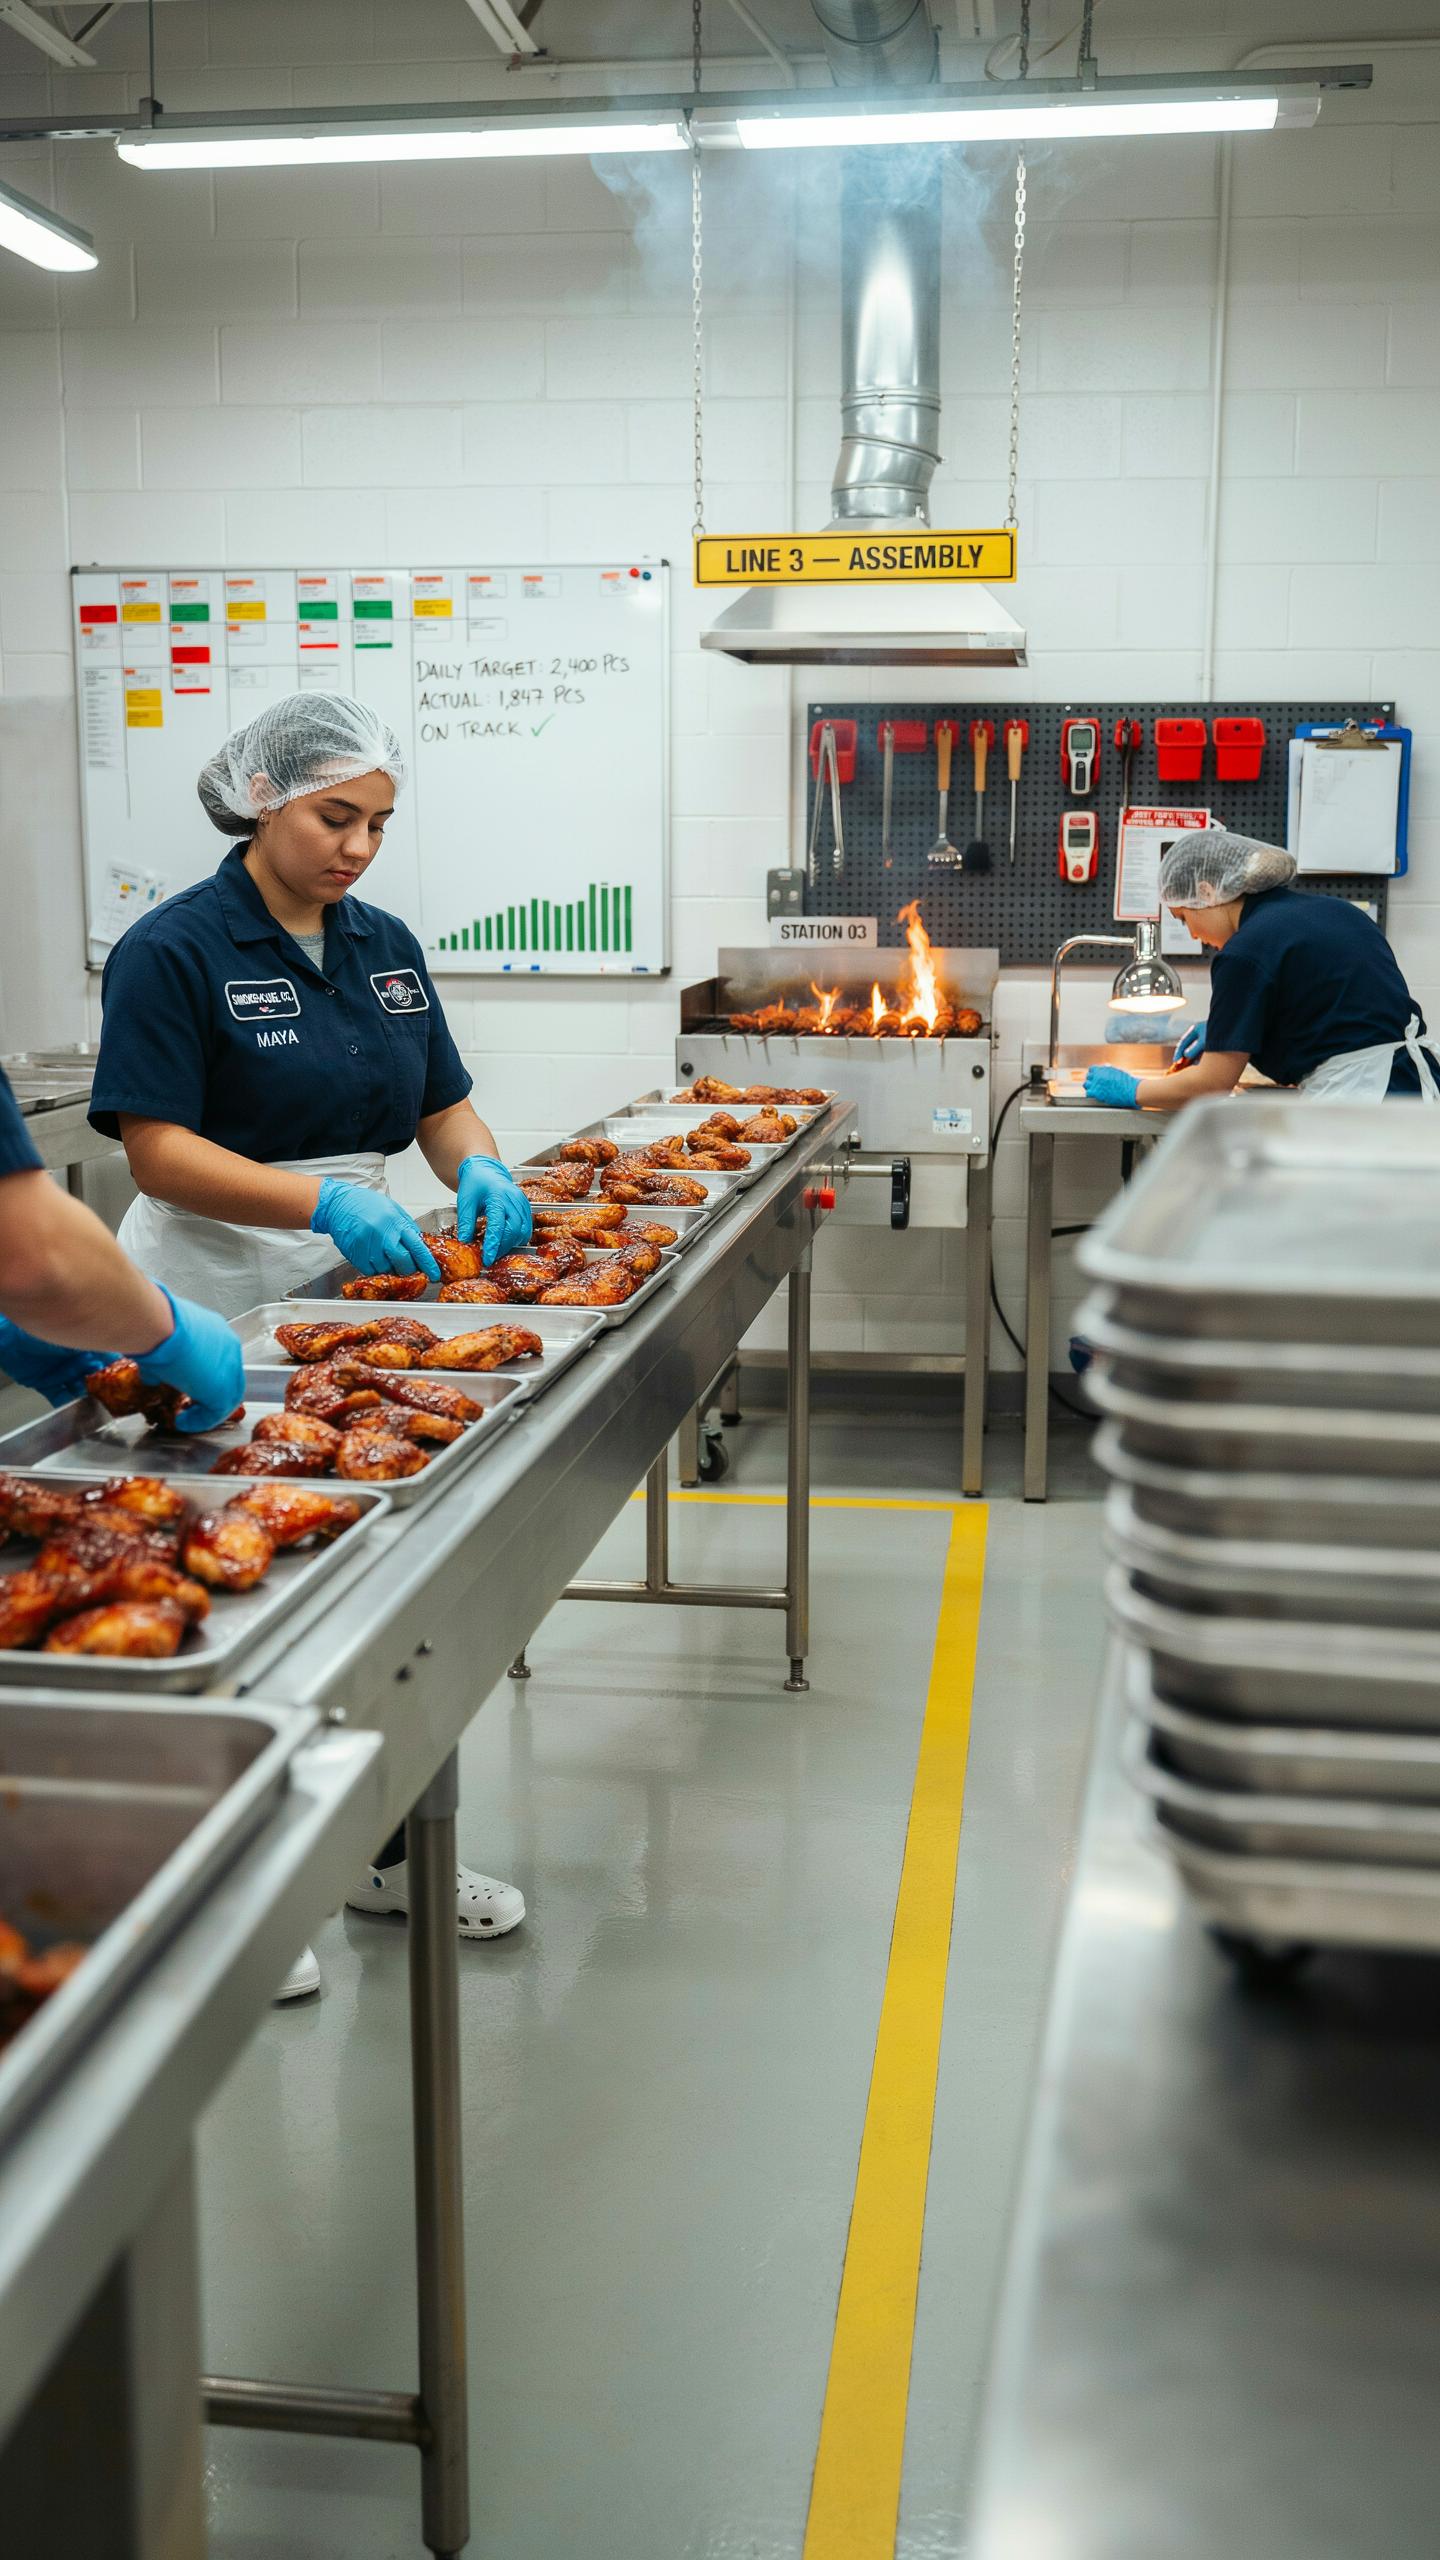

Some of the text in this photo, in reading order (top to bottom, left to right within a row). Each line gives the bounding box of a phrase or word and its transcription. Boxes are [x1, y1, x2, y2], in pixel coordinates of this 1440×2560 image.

[726, 548, 781, 573] LINE
[789, 548, 804, 572] 3
[848, 544, 984, 570] ASSEMBLY
[416, 653, 630, 683] DAILY TARGET: 2,400 PCS
[418, 685, 585, 711] ACTUAL: 1,847 PCS
[420, 720, 523, 742] ON TRACK
[781, 925, 867, 939] STATION 03
[256, 1029, 299, 1047] MAYA
